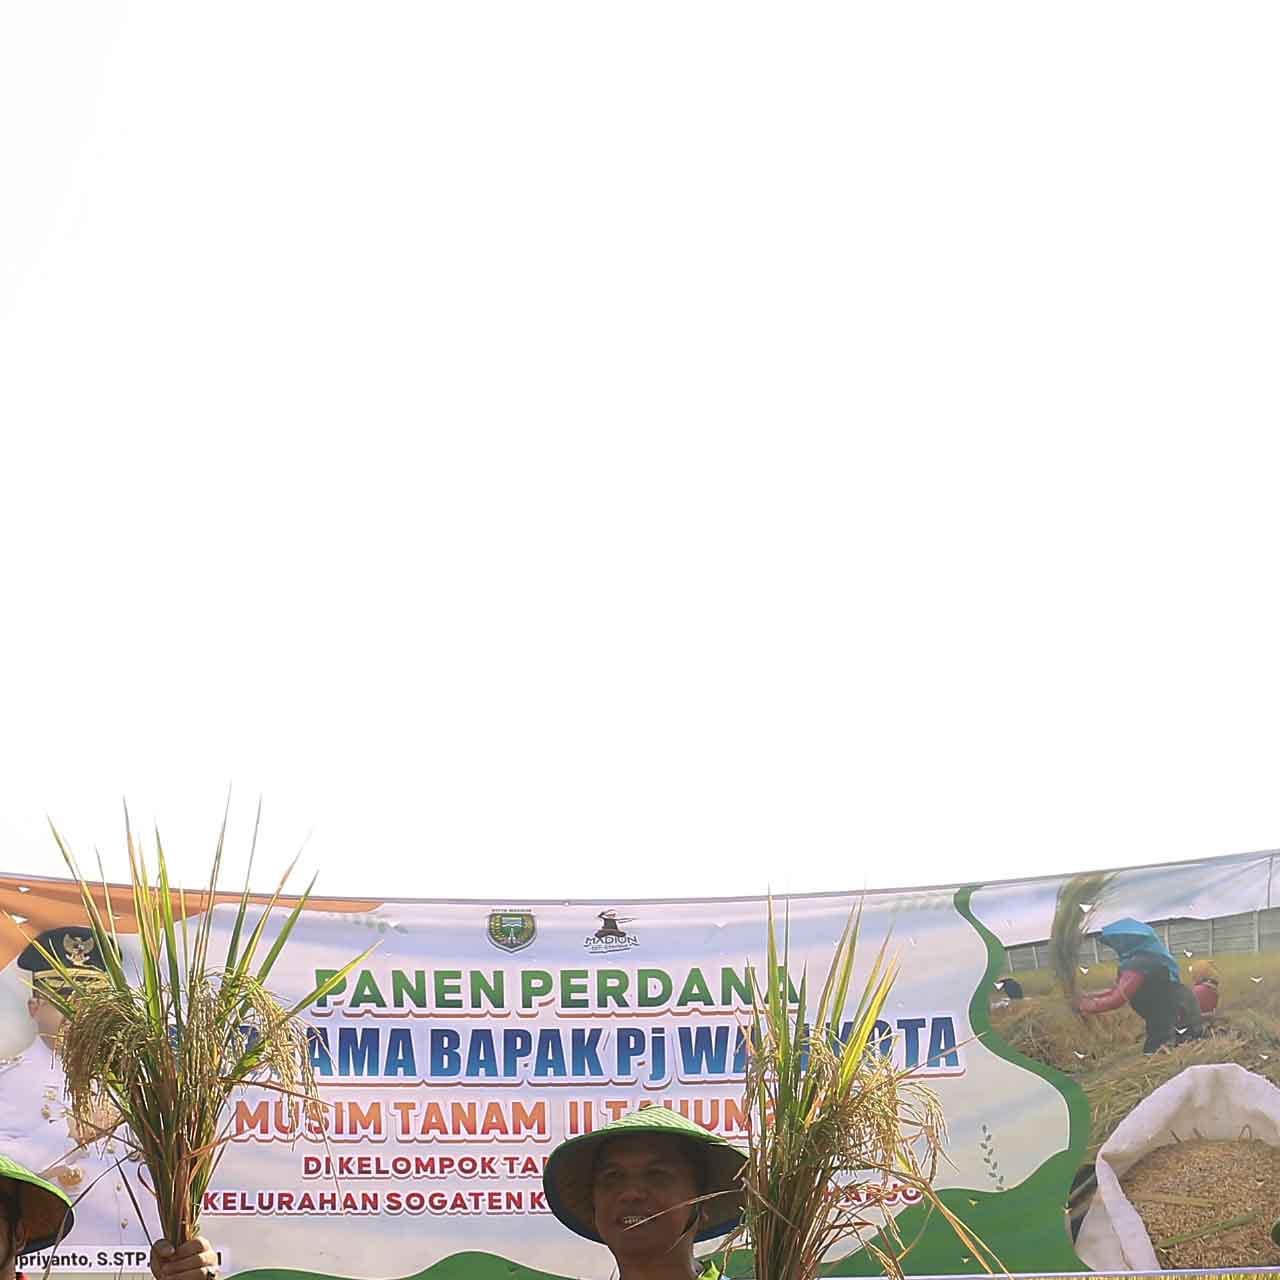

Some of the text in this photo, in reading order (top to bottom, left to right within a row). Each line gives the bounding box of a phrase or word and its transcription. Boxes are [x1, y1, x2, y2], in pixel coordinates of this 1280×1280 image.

[314, 966, 802, 1009] PANEN PERDANA
[431, 1028, 605, 1078] BAPAK
[617, 1026, 665, 1081] Pj
[236, 1101, 382, 1135] MUSIM
[394, 1101, 546, 1135] TANAM
[569, 1101, 593, 1135] II
[203, 1191, 378, 1211] KELURAHAN
[387, 1191, 522, 1211] SOGATEN
